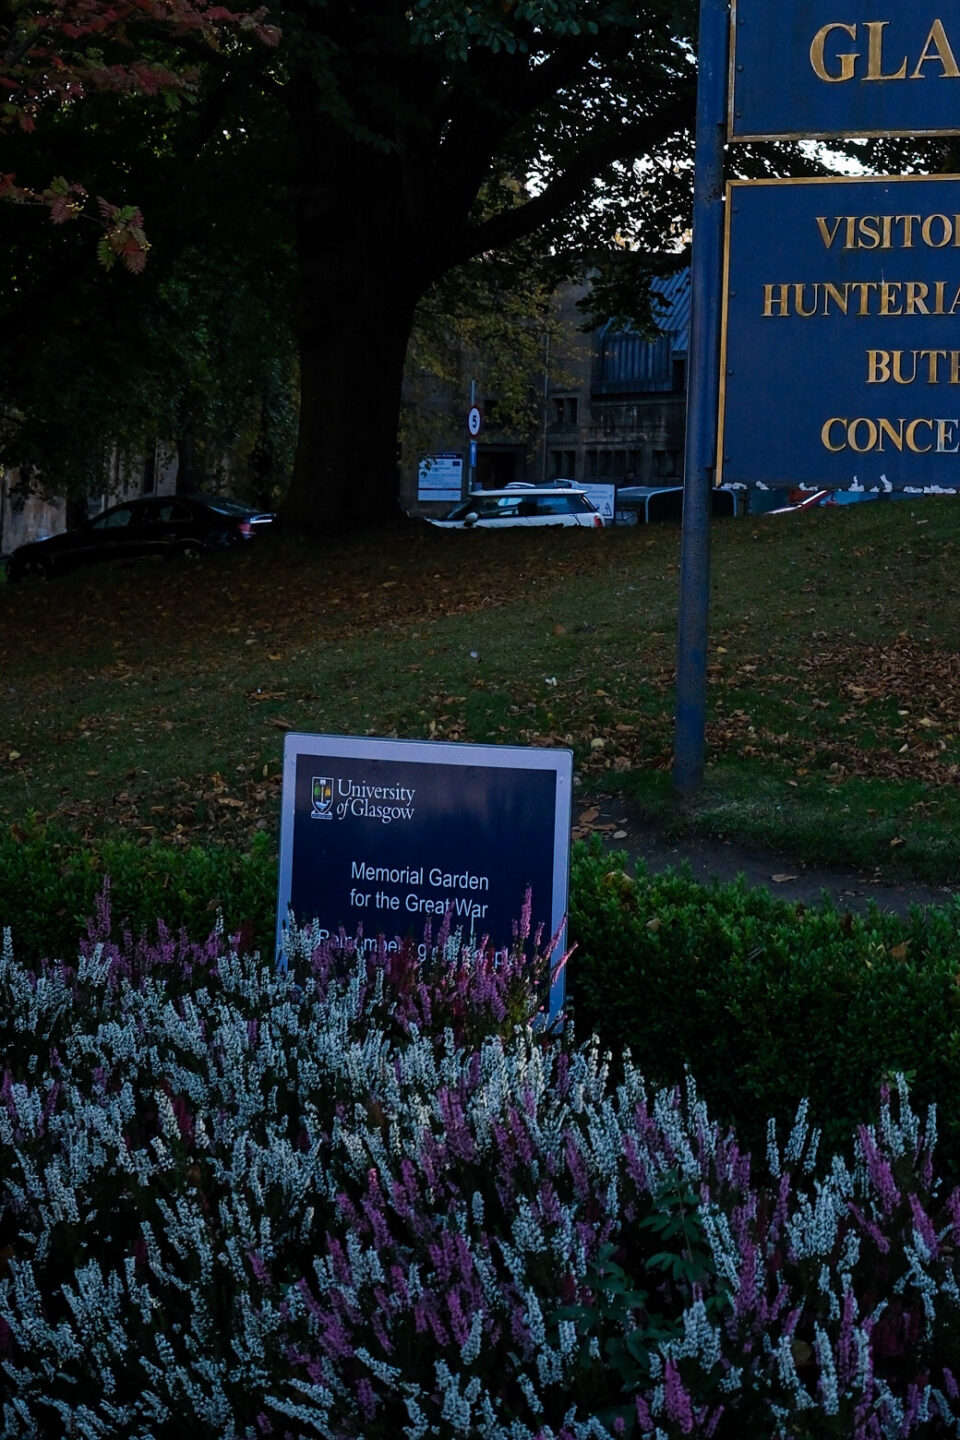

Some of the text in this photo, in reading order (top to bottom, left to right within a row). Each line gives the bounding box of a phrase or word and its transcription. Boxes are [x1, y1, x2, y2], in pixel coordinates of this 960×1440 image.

[472, 415, 477, 428] 5
[337, 778, 416, 807] University
[336, 796, 415, 824] of Glasgow
[351, 861, 489, 891] Memorial Garden
[350, 888, 489, 918] for the Great War
